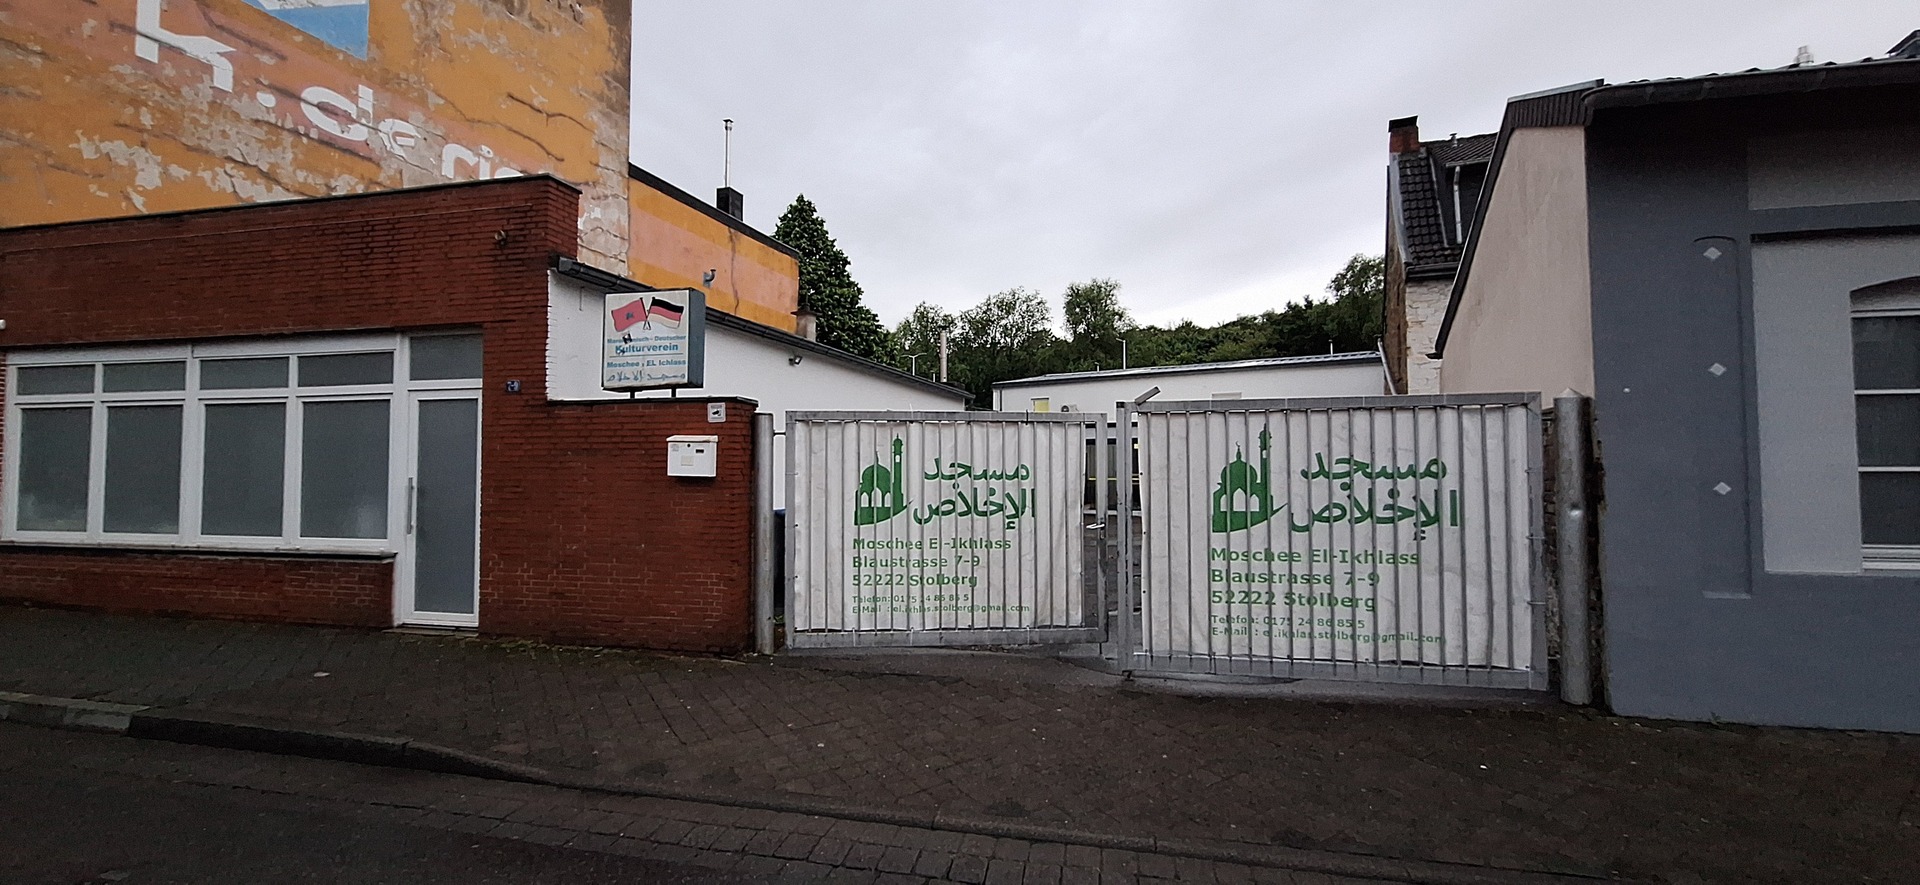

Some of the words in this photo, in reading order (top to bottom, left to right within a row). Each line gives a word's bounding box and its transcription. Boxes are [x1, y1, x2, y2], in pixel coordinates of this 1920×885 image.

[615, 343, 679, 353] Kulturverein
[924, 458, 1029, 489] مسجد
[1301, 452, 1446, 490] مسجد
[853, 538, 923, 550] Moschee
[929, 537, 1011, 550] E-Ikhlass
[852, 555, 948, 568] Blaustrasse
[954, 555, 981, 567] 7-9
[1211, 548, 1302, 562] Moschee
[1311, 549, 1420, 565] El-Ikhlass
[852, 574, 905, 587] 52222
[909, 573, 978, 588] Stolberg
[1211, 569, 1332, 585] Blaustrasse
[1343, 572, 1380, 587] 7-9
[893, 594, 917, 604] 015
[1211, 590, 1276, 606] 52222
[1283, 592, 1376, 612] Stolberg
[1211, 614, 1259, 625] Telefon:
[1317, 618, 1332, 627] 86
[1337, 618, 1353, 628] 85
[1357, 619, 1365, 629] 5
